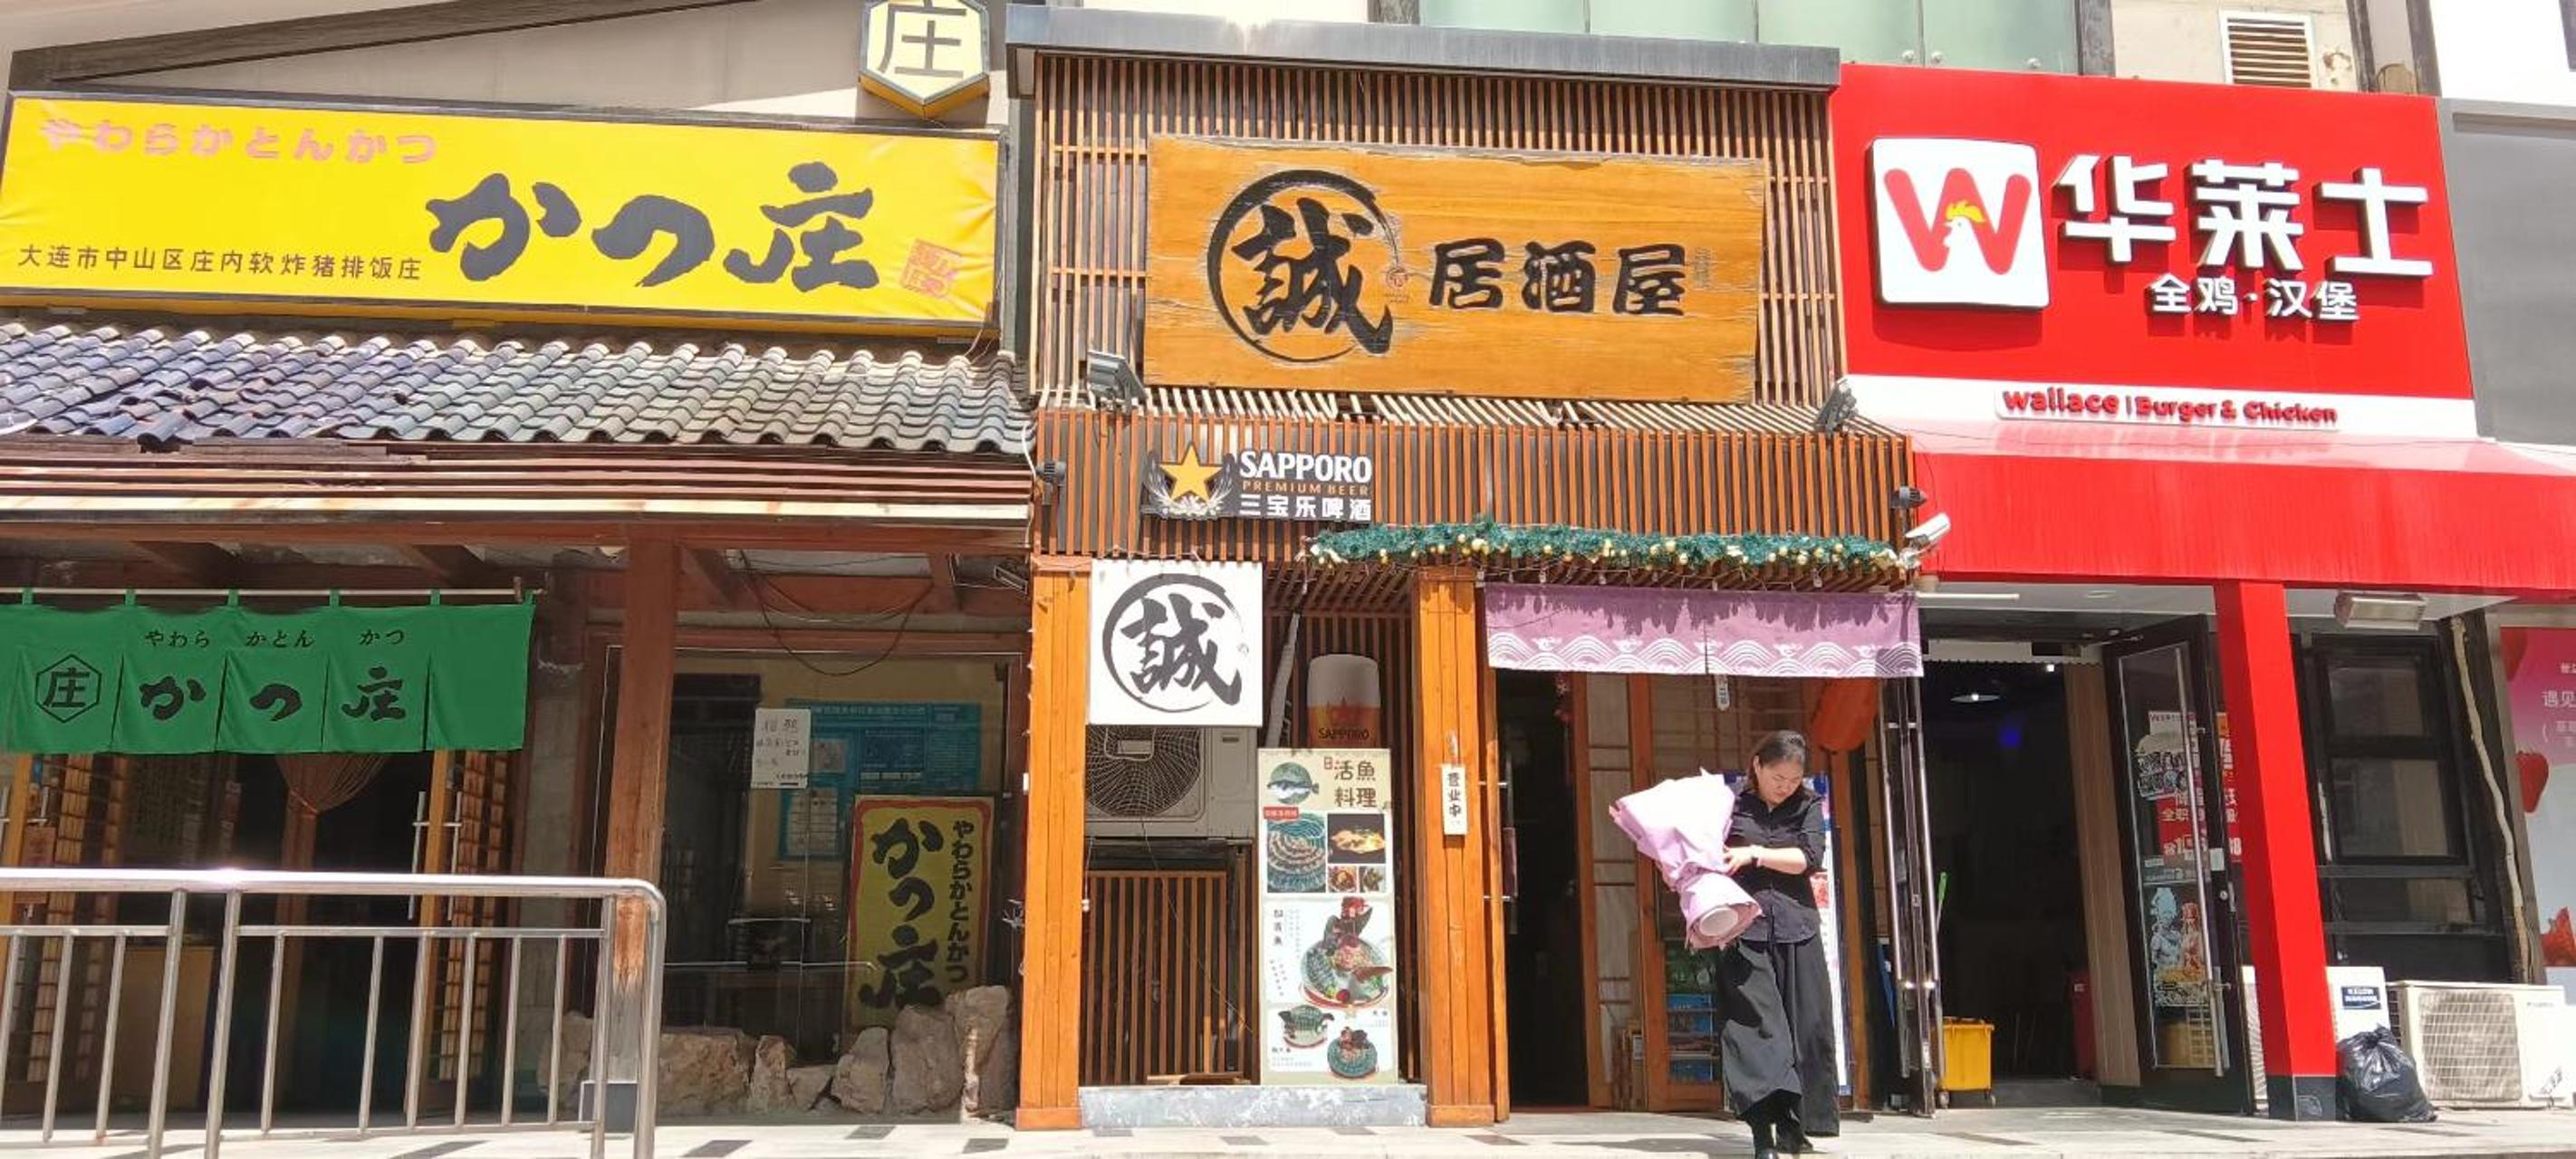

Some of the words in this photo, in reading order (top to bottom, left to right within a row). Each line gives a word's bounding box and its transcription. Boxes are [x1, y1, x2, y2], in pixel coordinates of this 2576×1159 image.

[876, 0, 967, 78] 庄
[40, 118, 437, 165] やわらかとんかつ
[425, 160, 879, 293] かつ庄
[2054, 154, 2434, 276] 华莱士
[17, 244, 422, 282] 大连市中山区庄内软炸猪排饭庄
[1428, 238, 1686, 316] 居酒屋
[2003, 387, 2119, 415] wallace
[2135, 397, 2217, 425] Burger
[2242, 400, 2339, 425] Chicken
[1239, 451, 1372, 484] SAPPORO
[1239, 494, 1372, 522] 三宝乐啤酒
[1242, 481, 1321, 493] PREMIUM
[1328, 484, 1370, 496] BEER
[42, 668, 91, 708] 庄
[1334, 761, 1376, 781] 活魚
[1334, 787, 1377, 808] 料理
[859, 818, 947, 1009] かつ庄
[946, 819, 975, 983] やわらかとんかつ
